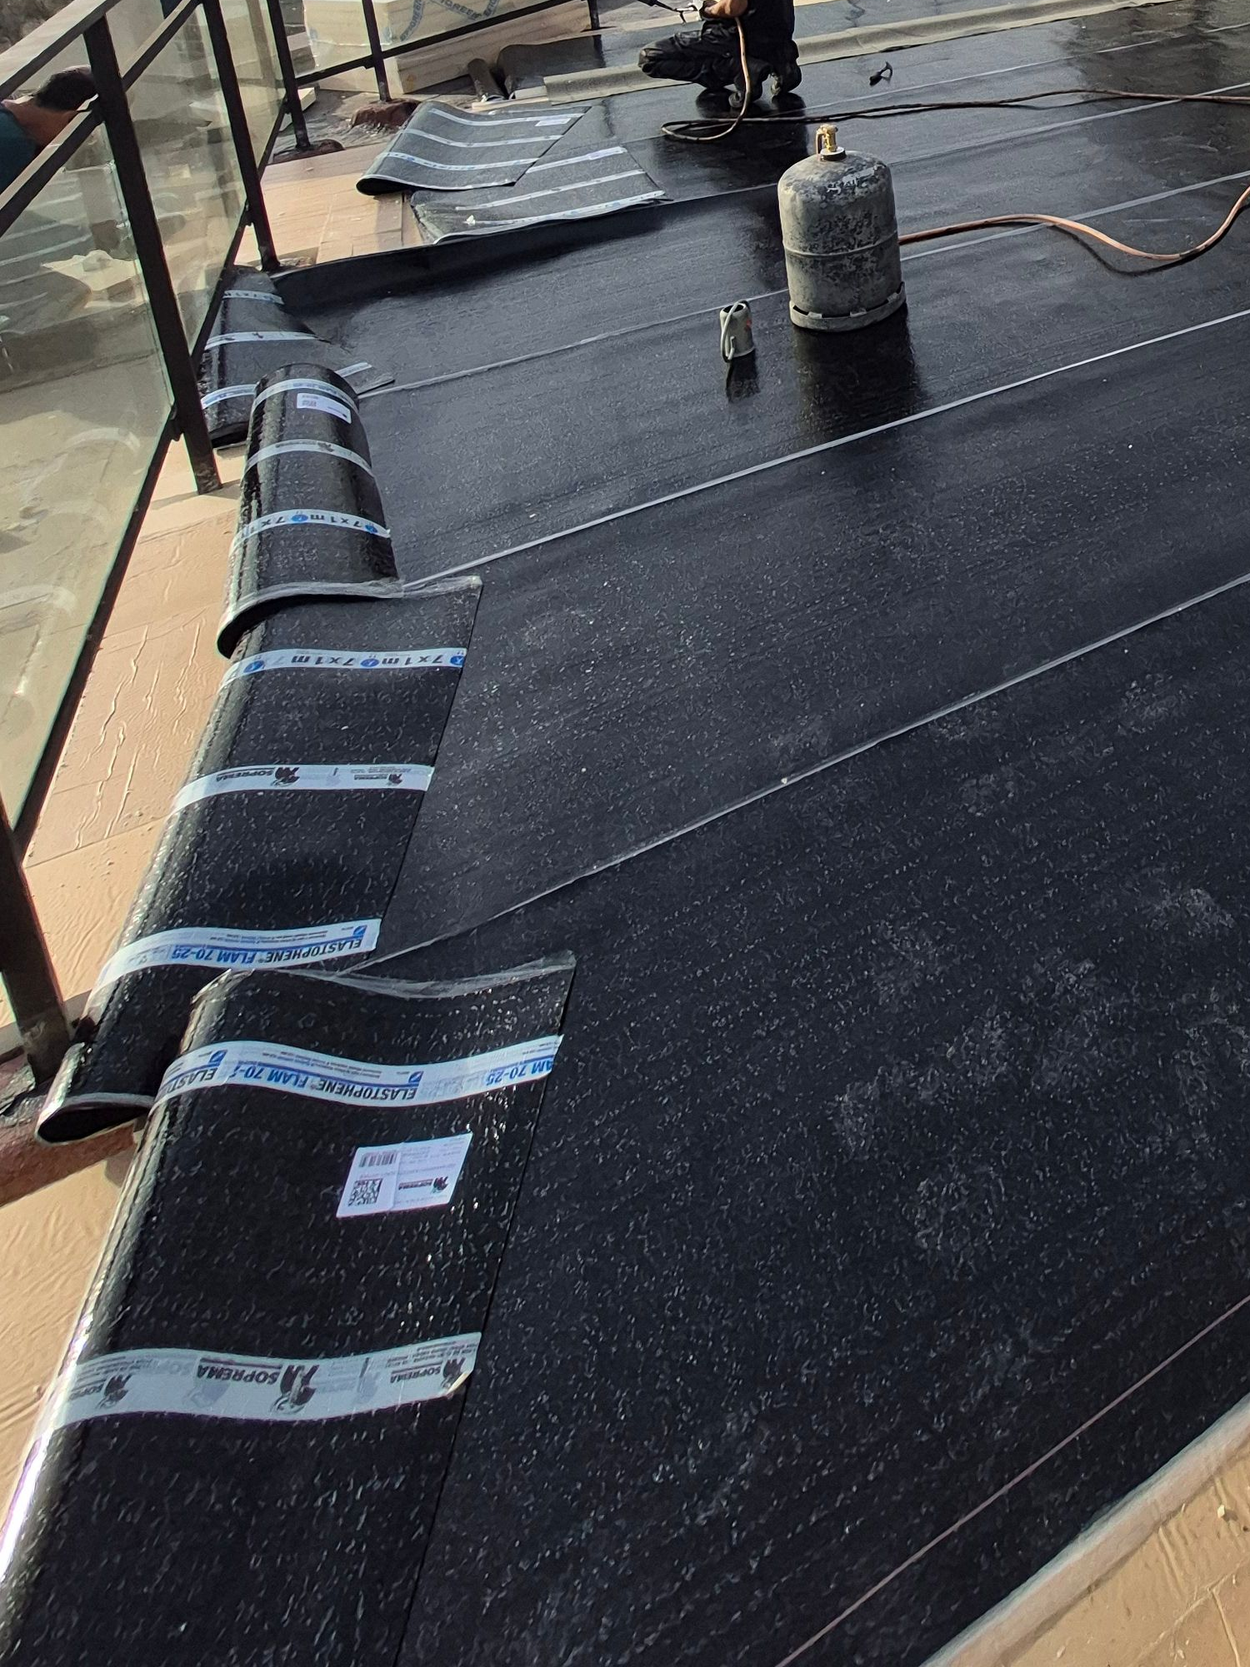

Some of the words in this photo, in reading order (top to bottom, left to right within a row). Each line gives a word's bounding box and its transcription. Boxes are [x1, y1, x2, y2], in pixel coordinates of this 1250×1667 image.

[216, 769, 275, 783] SOPREMA
[171, 947, 214, 963] 70-25
[214, 950, 257, 965] FLAM
[267, 1069, 309, 1088] FLAM
[486, 1064, 528, 1087] 70-25
[197, 1365, 281, 1386] SOPREMA
[390, 1365, 442, 1384] SOPREMA
